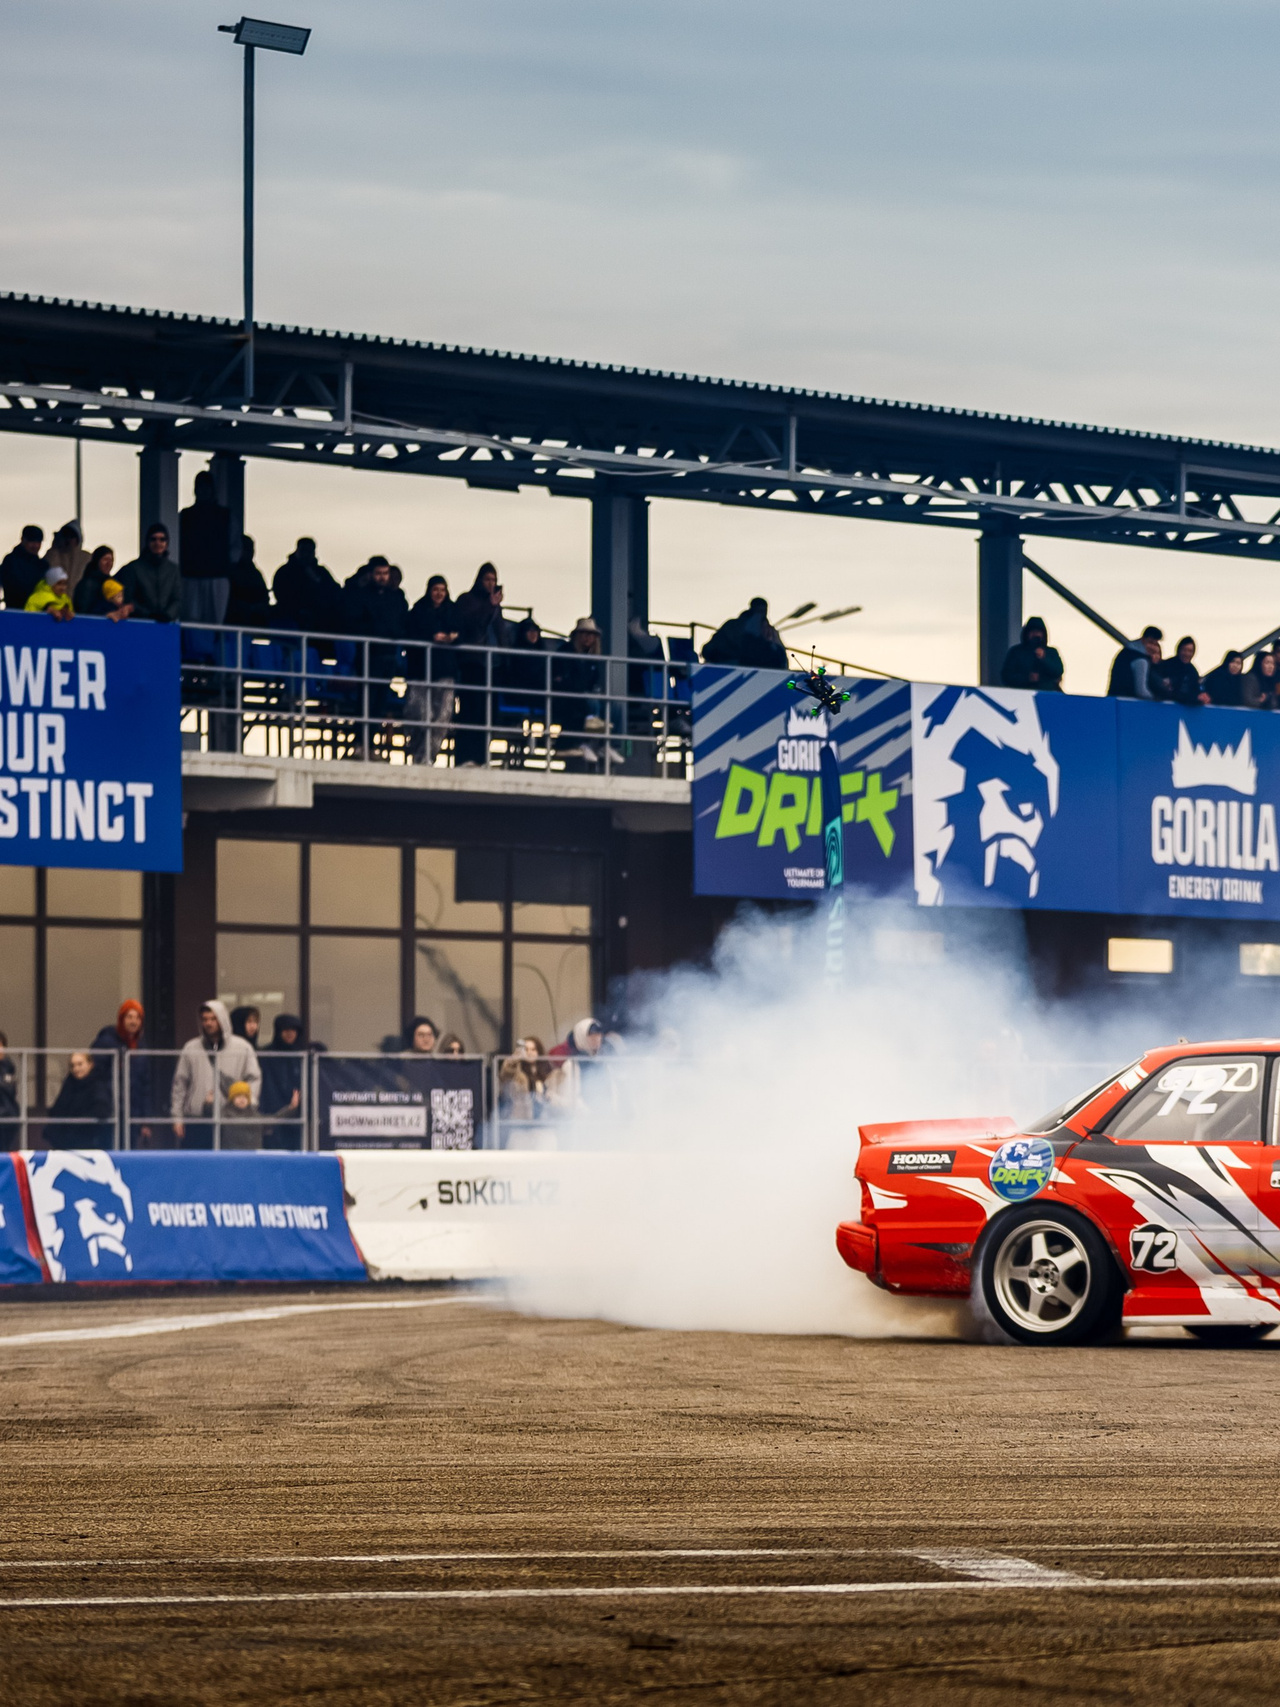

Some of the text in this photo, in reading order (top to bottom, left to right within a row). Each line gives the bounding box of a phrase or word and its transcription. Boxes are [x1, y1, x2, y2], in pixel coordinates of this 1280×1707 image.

[0, 645, 107, 711] WER
[0, 711, 66, 774] UR
[1151, 795, 1280, 872] GORILLA
[1168, 875, 1262, 903] ENERGY DRINK
[1157, 1067, 1228, 1116] 72
[892, 1153, 951, 1164] HONDA
[148, 1202, 328, 1229] POWER YOUR INSTINCT
[1131, 1230, 1178, 1269] 72
